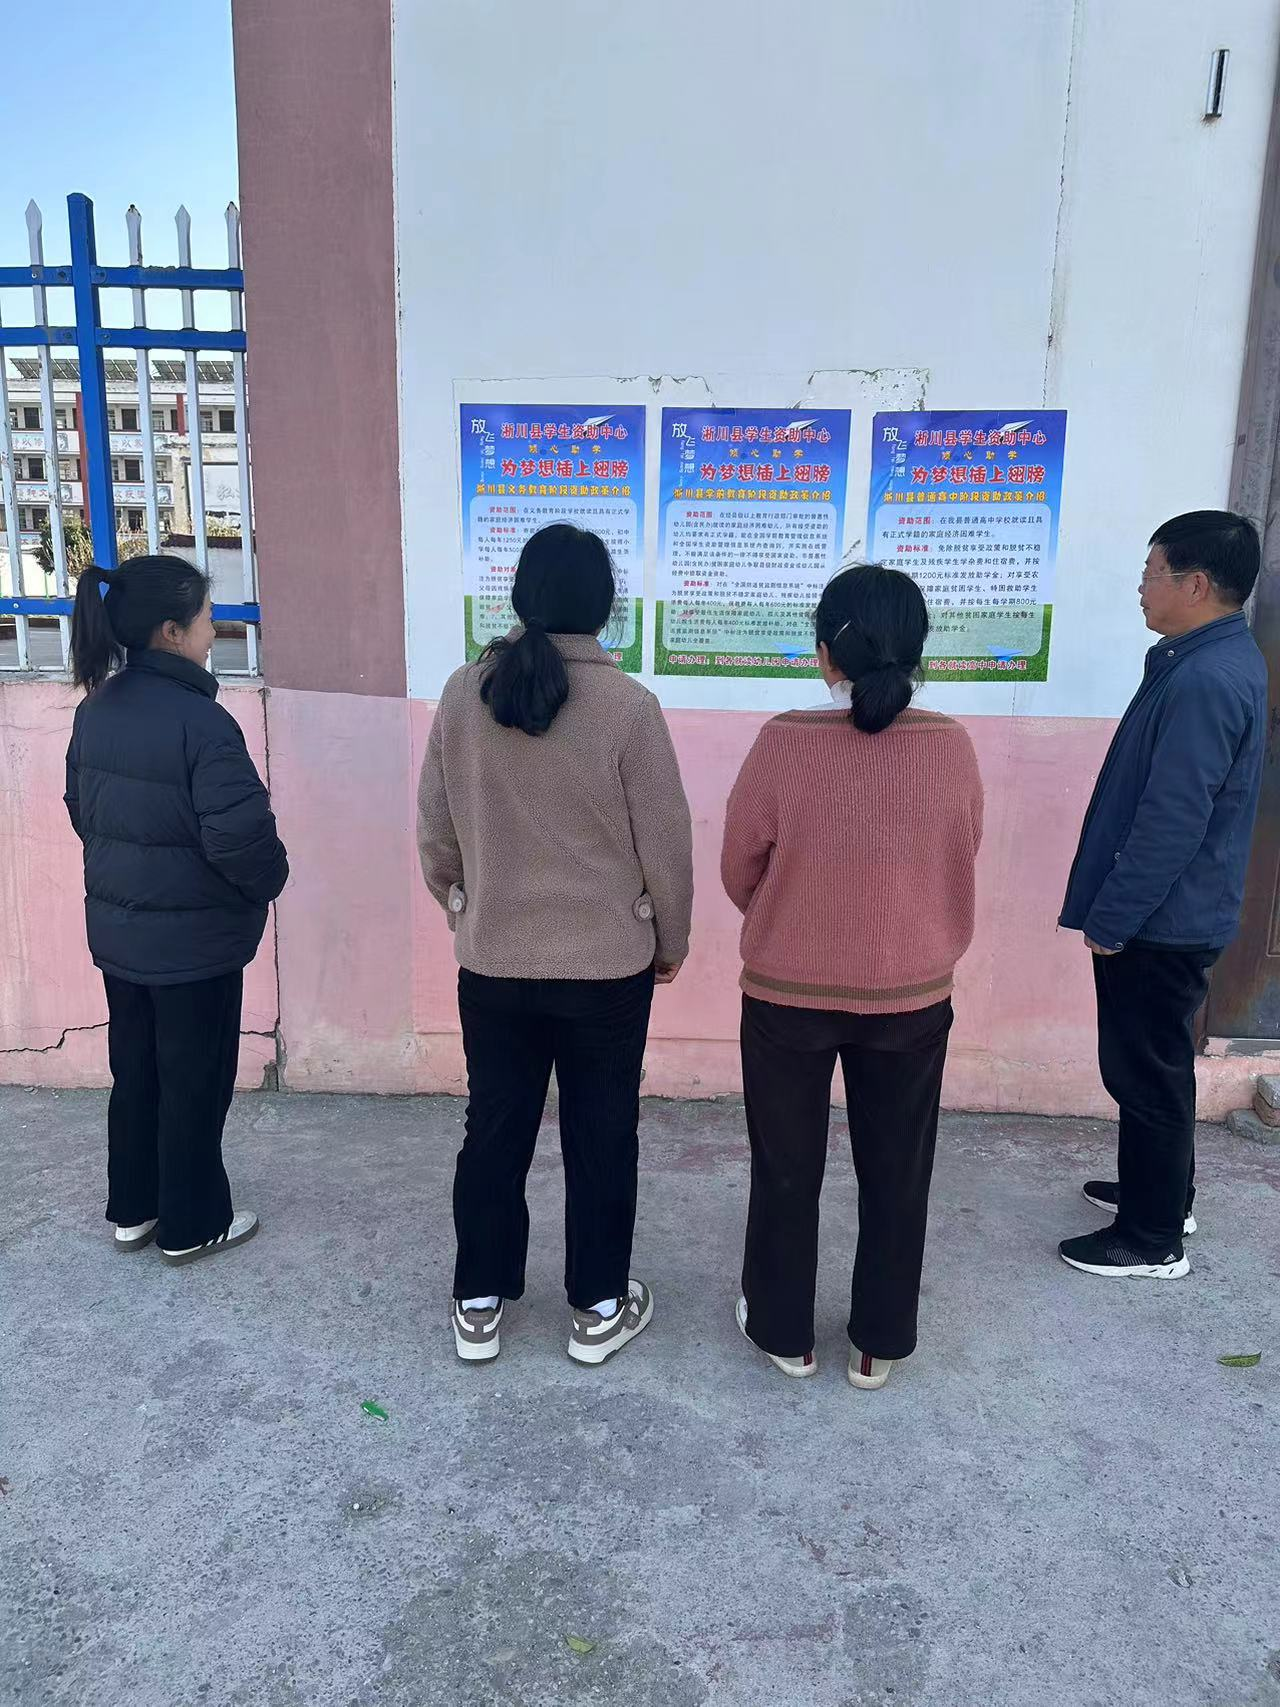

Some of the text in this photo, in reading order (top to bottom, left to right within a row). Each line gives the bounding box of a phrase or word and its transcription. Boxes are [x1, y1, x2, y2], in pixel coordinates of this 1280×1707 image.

[501, 423, 629, 440] 淅川县学生资助中心
[702, 426, 832, 444] 淅川县学生资助中心
[914, 430, 1047, 446] 淅川县学生资助中心
[471, 418, 495, 470] 放飞梦想
[672, 423, 696, 474] 放飞梦想
[882, 427, 907, 477] 放飞梦想
[501, 458, 629, 479] 为梦想插上翅膀
[700, 463, 831, 483] 为梦想插上翅膀
[911, 465, 1046, 485] 为梦想插上翅膀
[476, 484, 631, 496] 淅川县义务教育阶段资助政策介绍
[884, 491, 1047, 504] 淅川县普通高中阶段资助政策介绍
